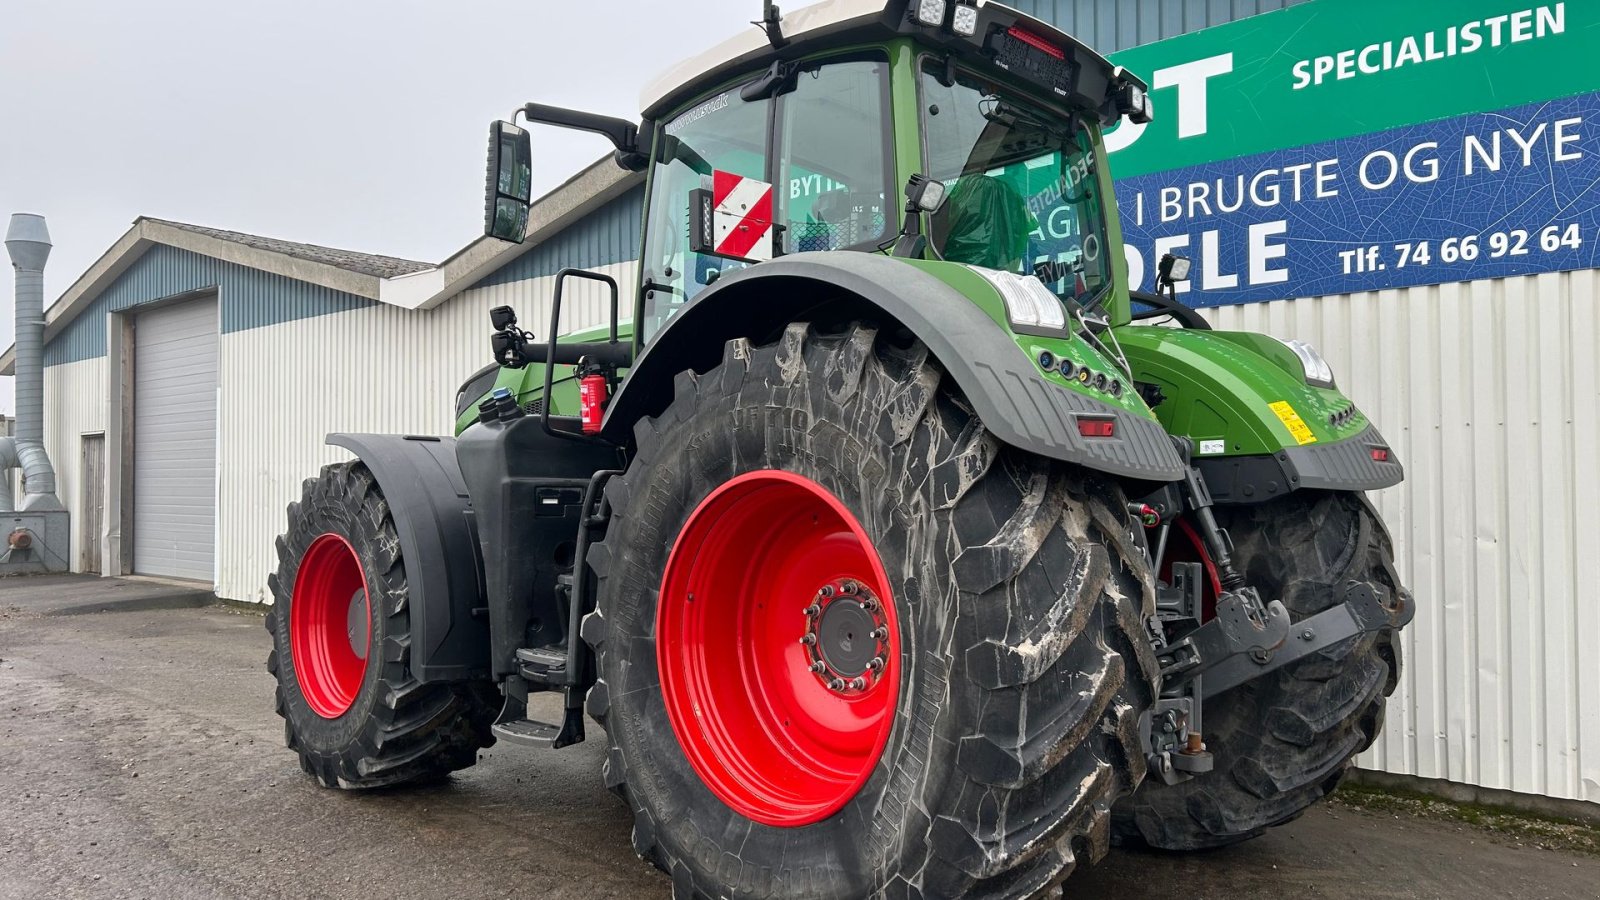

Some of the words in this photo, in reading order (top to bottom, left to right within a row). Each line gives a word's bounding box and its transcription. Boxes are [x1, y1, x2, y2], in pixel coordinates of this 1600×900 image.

[1292, 2, 1565, 90] SPECIALISTEN
[1136, 192, 1143, 226] I
[1161, 158, 1339, 223] BRUGTE
[1358, 141, 1440, 190] OG
[1465, 116, 1583, 176] NYE
[1339, 245, 1386, 274] Tlf.
[1394, 241, 1431, 268] 74
[1440, 235, 1479, 263] 66
[1489, 229, 1529, 258] 92
[1540, 223, 1582, 252] 64
